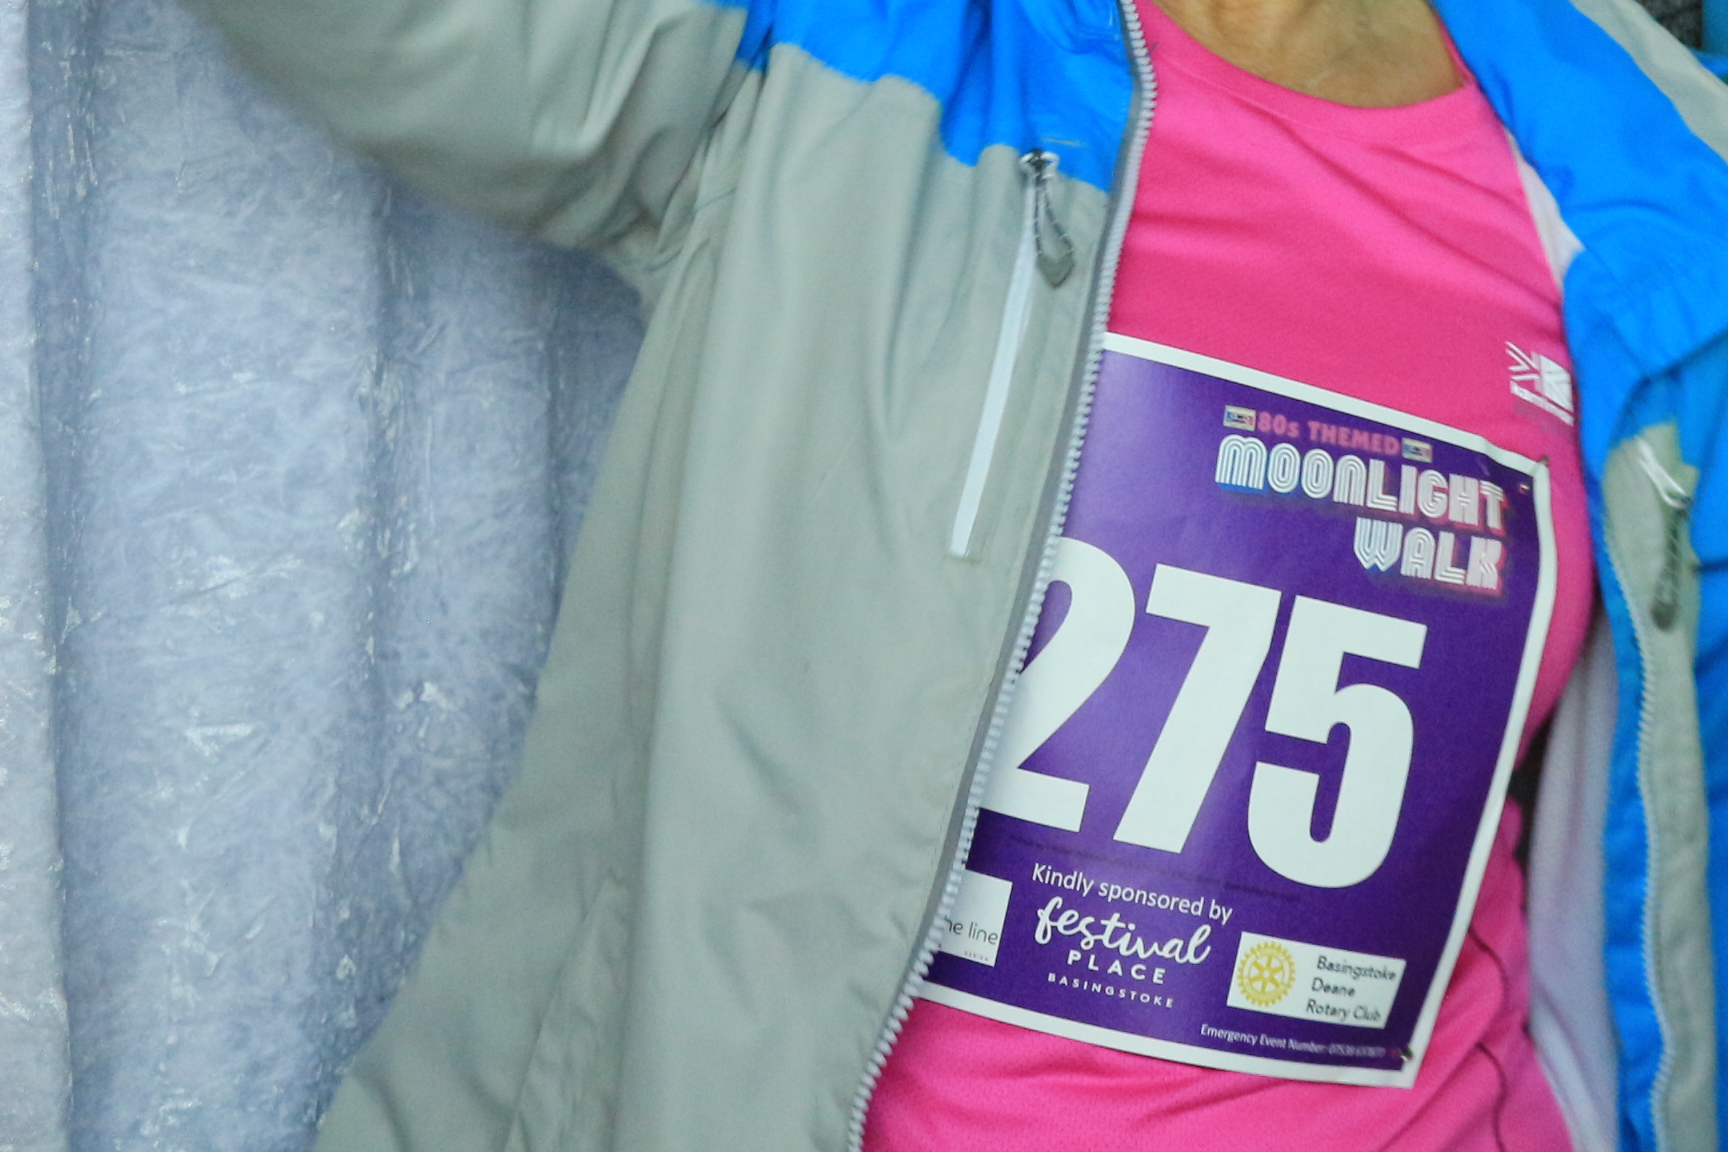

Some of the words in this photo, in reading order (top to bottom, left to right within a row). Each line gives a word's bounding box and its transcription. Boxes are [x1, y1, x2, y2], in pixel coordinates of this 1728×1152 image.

[1257, 410, 1300, 438] 80s
[1307, 420, 1400, 456] THEMED
[1215, 434, 1505, 532] MOONLIGHT
[1353, 516, 1503, 592] WALK
[978, 536, 1428, 888] 275
[1032, 862, 1094, 897] Kindly
[1098, 879, 1204, 917] sponsored
[1208, 900, 1232, 926] by
[943, 915, 963, 935] he
[968, 921, 999, 946] line
[1034, 896, 1212, 965] festival
[1067, 950, 1166, 984] PLACE
[1316, 955, 1397, 981] Basingstoke
[1048, 972, 1174, 1008] BASINGSTOKE
[1312, 977, 1356, 998] Deane
[1306, 999, 1350, 1023] Rotary
[1353, 1005, 1381, 1022] Club
[1200, 1023, 1258, 1046] Emergency
[1260, 1034, 1286, 1049] Event
